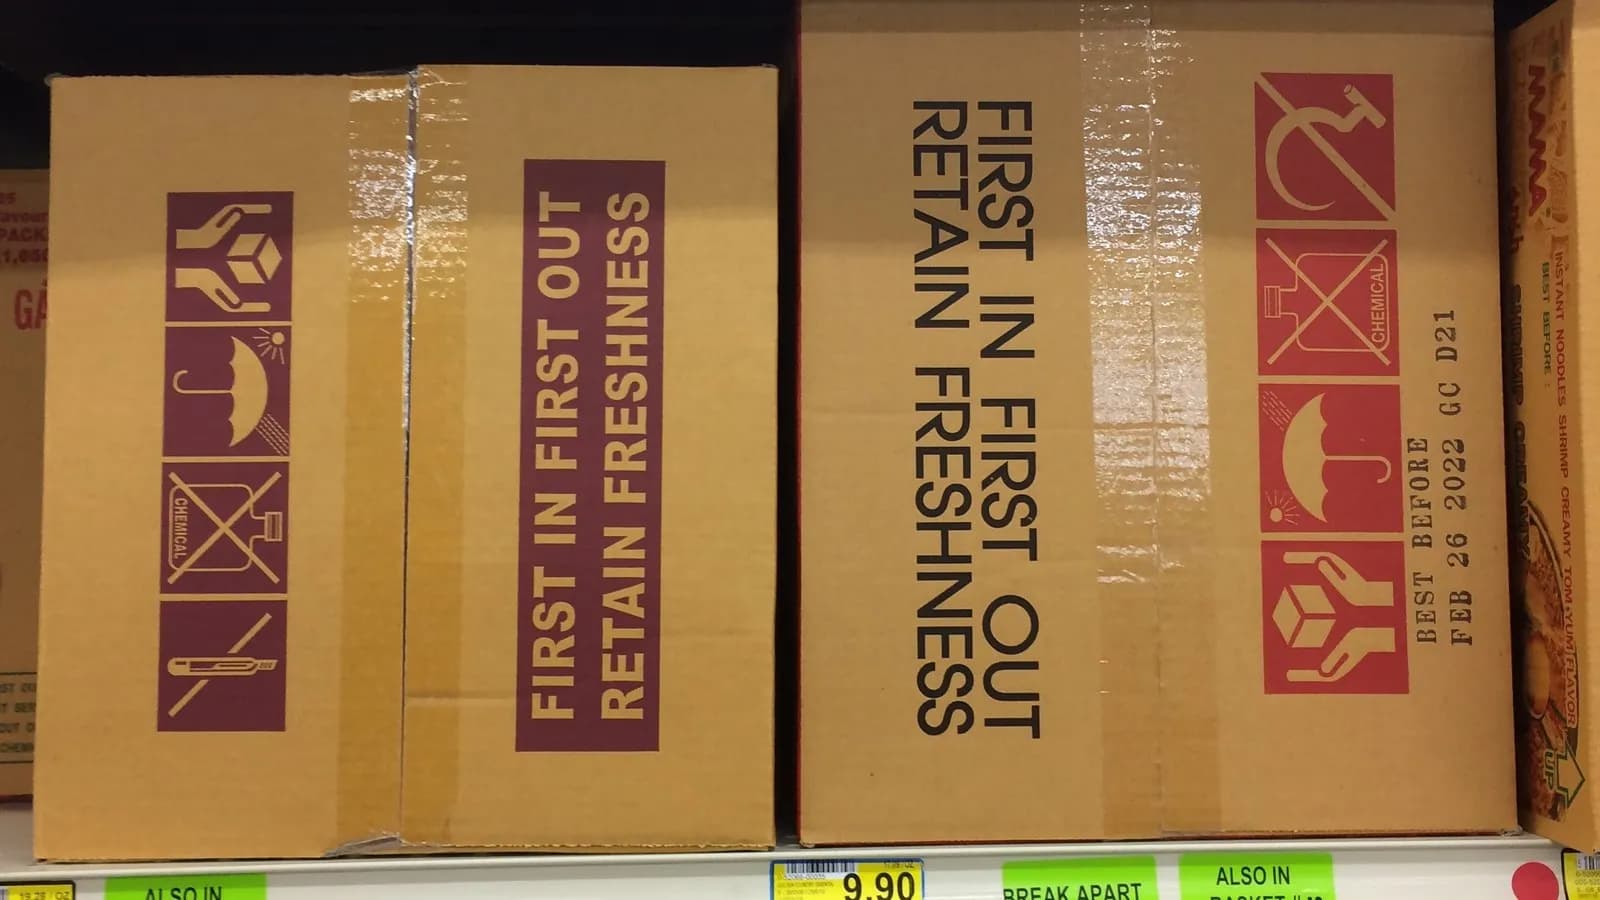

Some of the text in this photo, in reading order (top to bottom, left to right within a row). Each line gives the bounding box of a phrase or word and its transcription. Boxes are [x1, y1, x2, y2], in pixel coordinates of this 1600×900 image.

[1528, 65, 1547, 217] MAMA
[1369, 263, 1385, 343] CHEMICAL
[1541, 262, 1550, 303] BEST
[1554, 252, 1565, 321] INSTANT
[1542, 311, 1552, 376] BEFORE
[1556, 329, 1568, 407] NOODLES
[913, 101, 974, 736] RETAIN FRESHNESS
[977, 101, 1040, 739] FIRST IN FIRST OUT
[1558, 415, 1569, 479] SHRIMP
[531, 191, 581, 719] FIRST IN FIRST OUT
[600, 192, 650, 719] RETAIN FRESHNESS
[1433, 309, 1473, 647] FEB 26 2022 GC D21
[174, 498, 188, 559] CHEMICAL
[1407, 437, 1437, 644] BEST BEFORE
[1560, 487, 1571, 559] CREAMY
[1564, 657, 1577, 729] FLAVOR
[1543, 749, 1553, 791] UP
[145, 885, 222, 900] ALSO IN
[842, 871, 916, 900] 9.90
[1003, 882, 1142, 900] BREAK APART
[1216, 865, 1291, 886] ALSO IN
